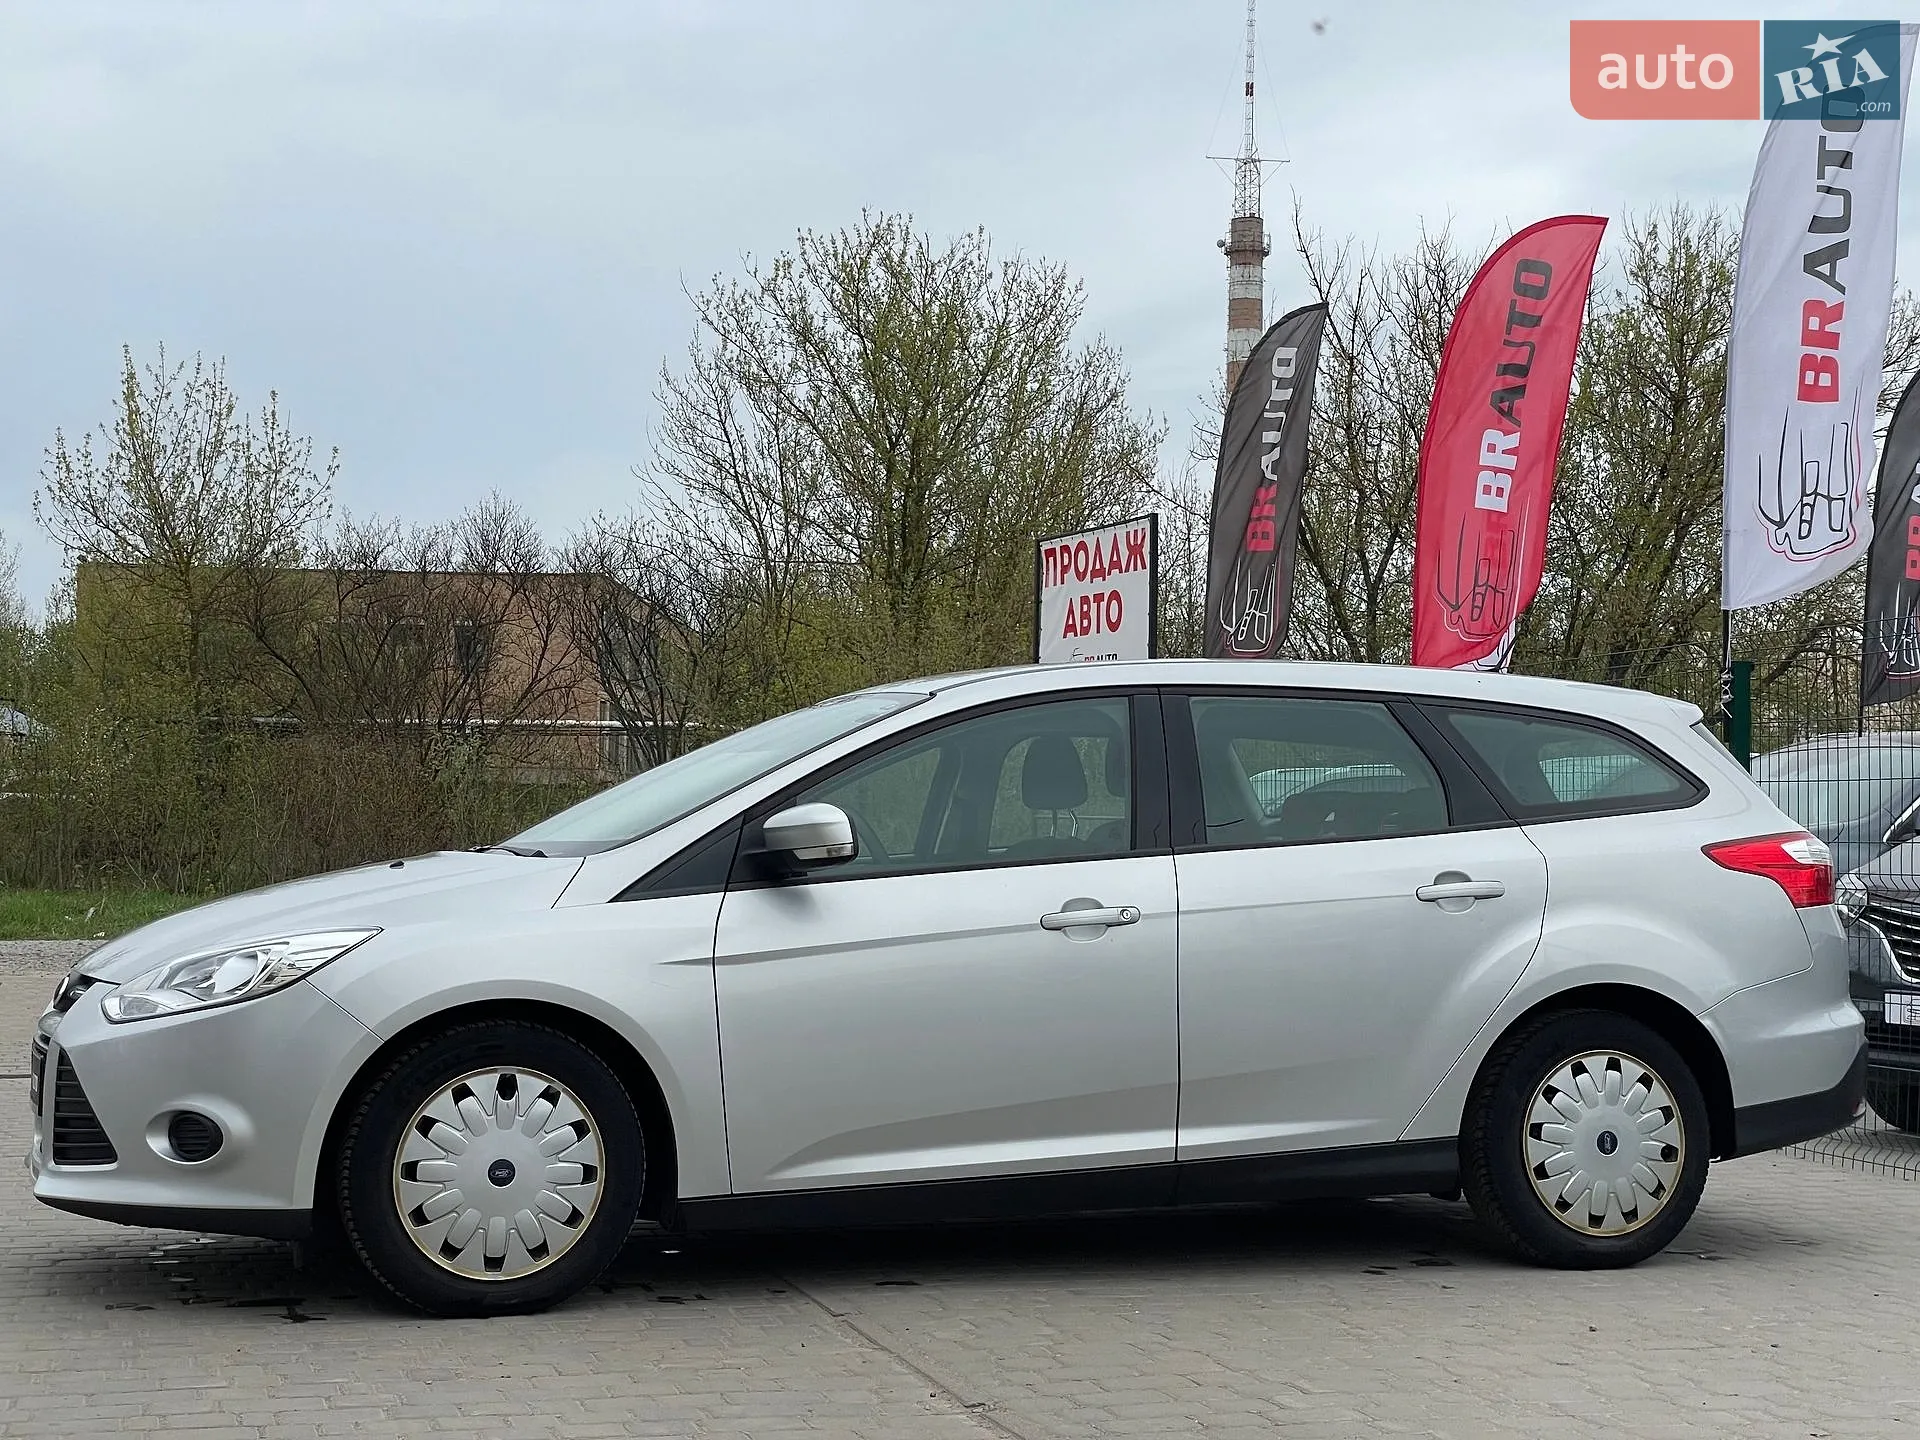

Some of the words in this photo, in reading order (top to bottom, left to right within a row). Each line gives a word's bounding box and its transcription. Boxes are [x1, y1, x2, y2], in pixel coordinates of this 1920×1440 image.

[1796, 84, 1866, 403] BRAUTO
[1246, 346, 1298, 552] BRAUTO
[1474, 258, 1553, 513] BRAUTO
[1043, 527, 1148, 589] ПРОДАЖ
[1062, 589, 1123, 639] АВТО
